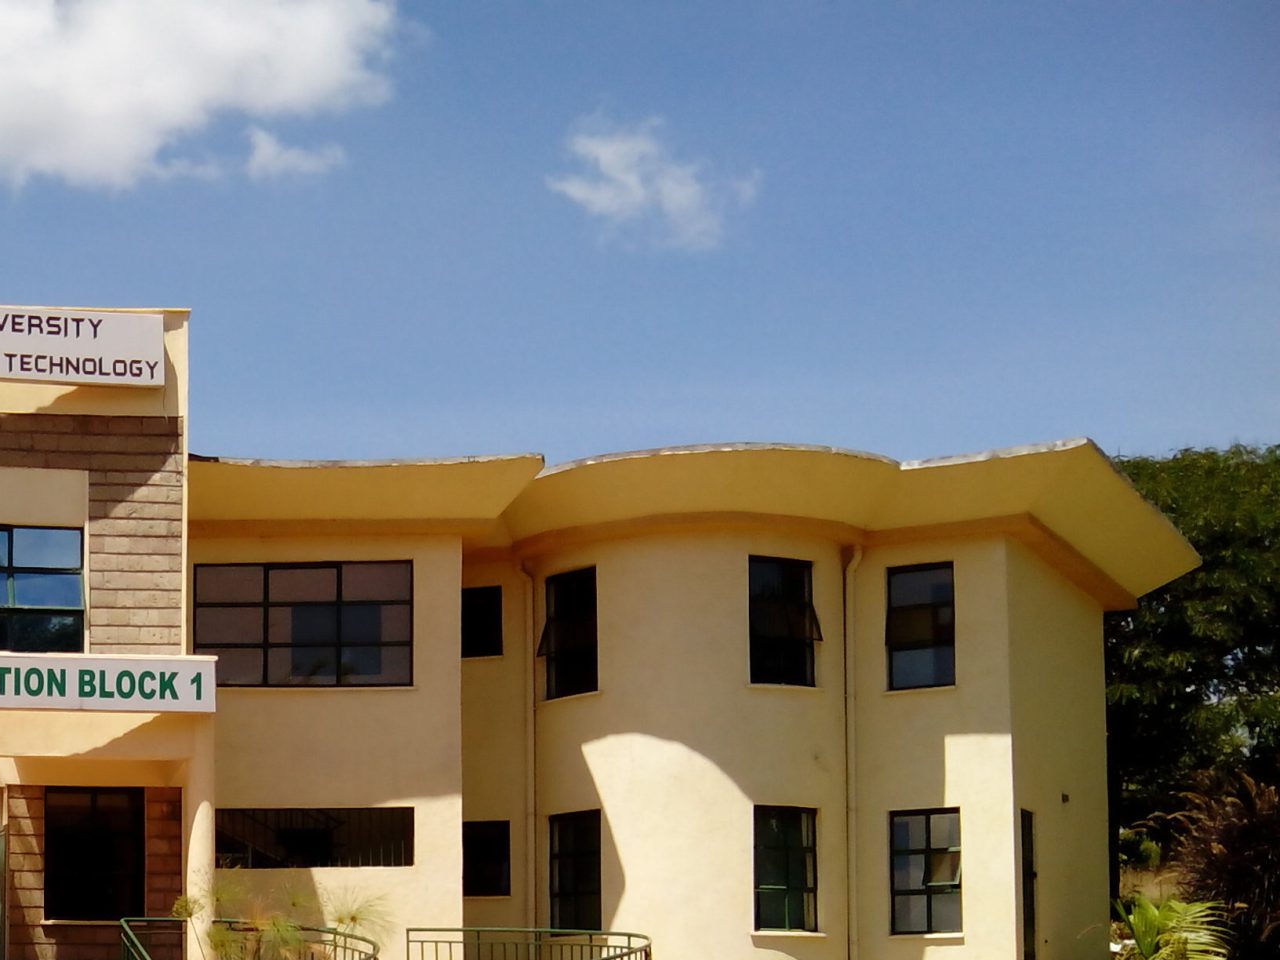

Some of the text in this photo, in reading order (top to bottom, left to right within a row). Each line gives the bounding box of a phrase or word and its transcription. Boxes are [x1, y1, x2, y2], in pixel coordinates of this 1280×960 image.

[3, 352, 160, 380] TECHNOLOGY
[78, 668, 180, 701] BLOCK
[190, 671, 202, 701] 1
